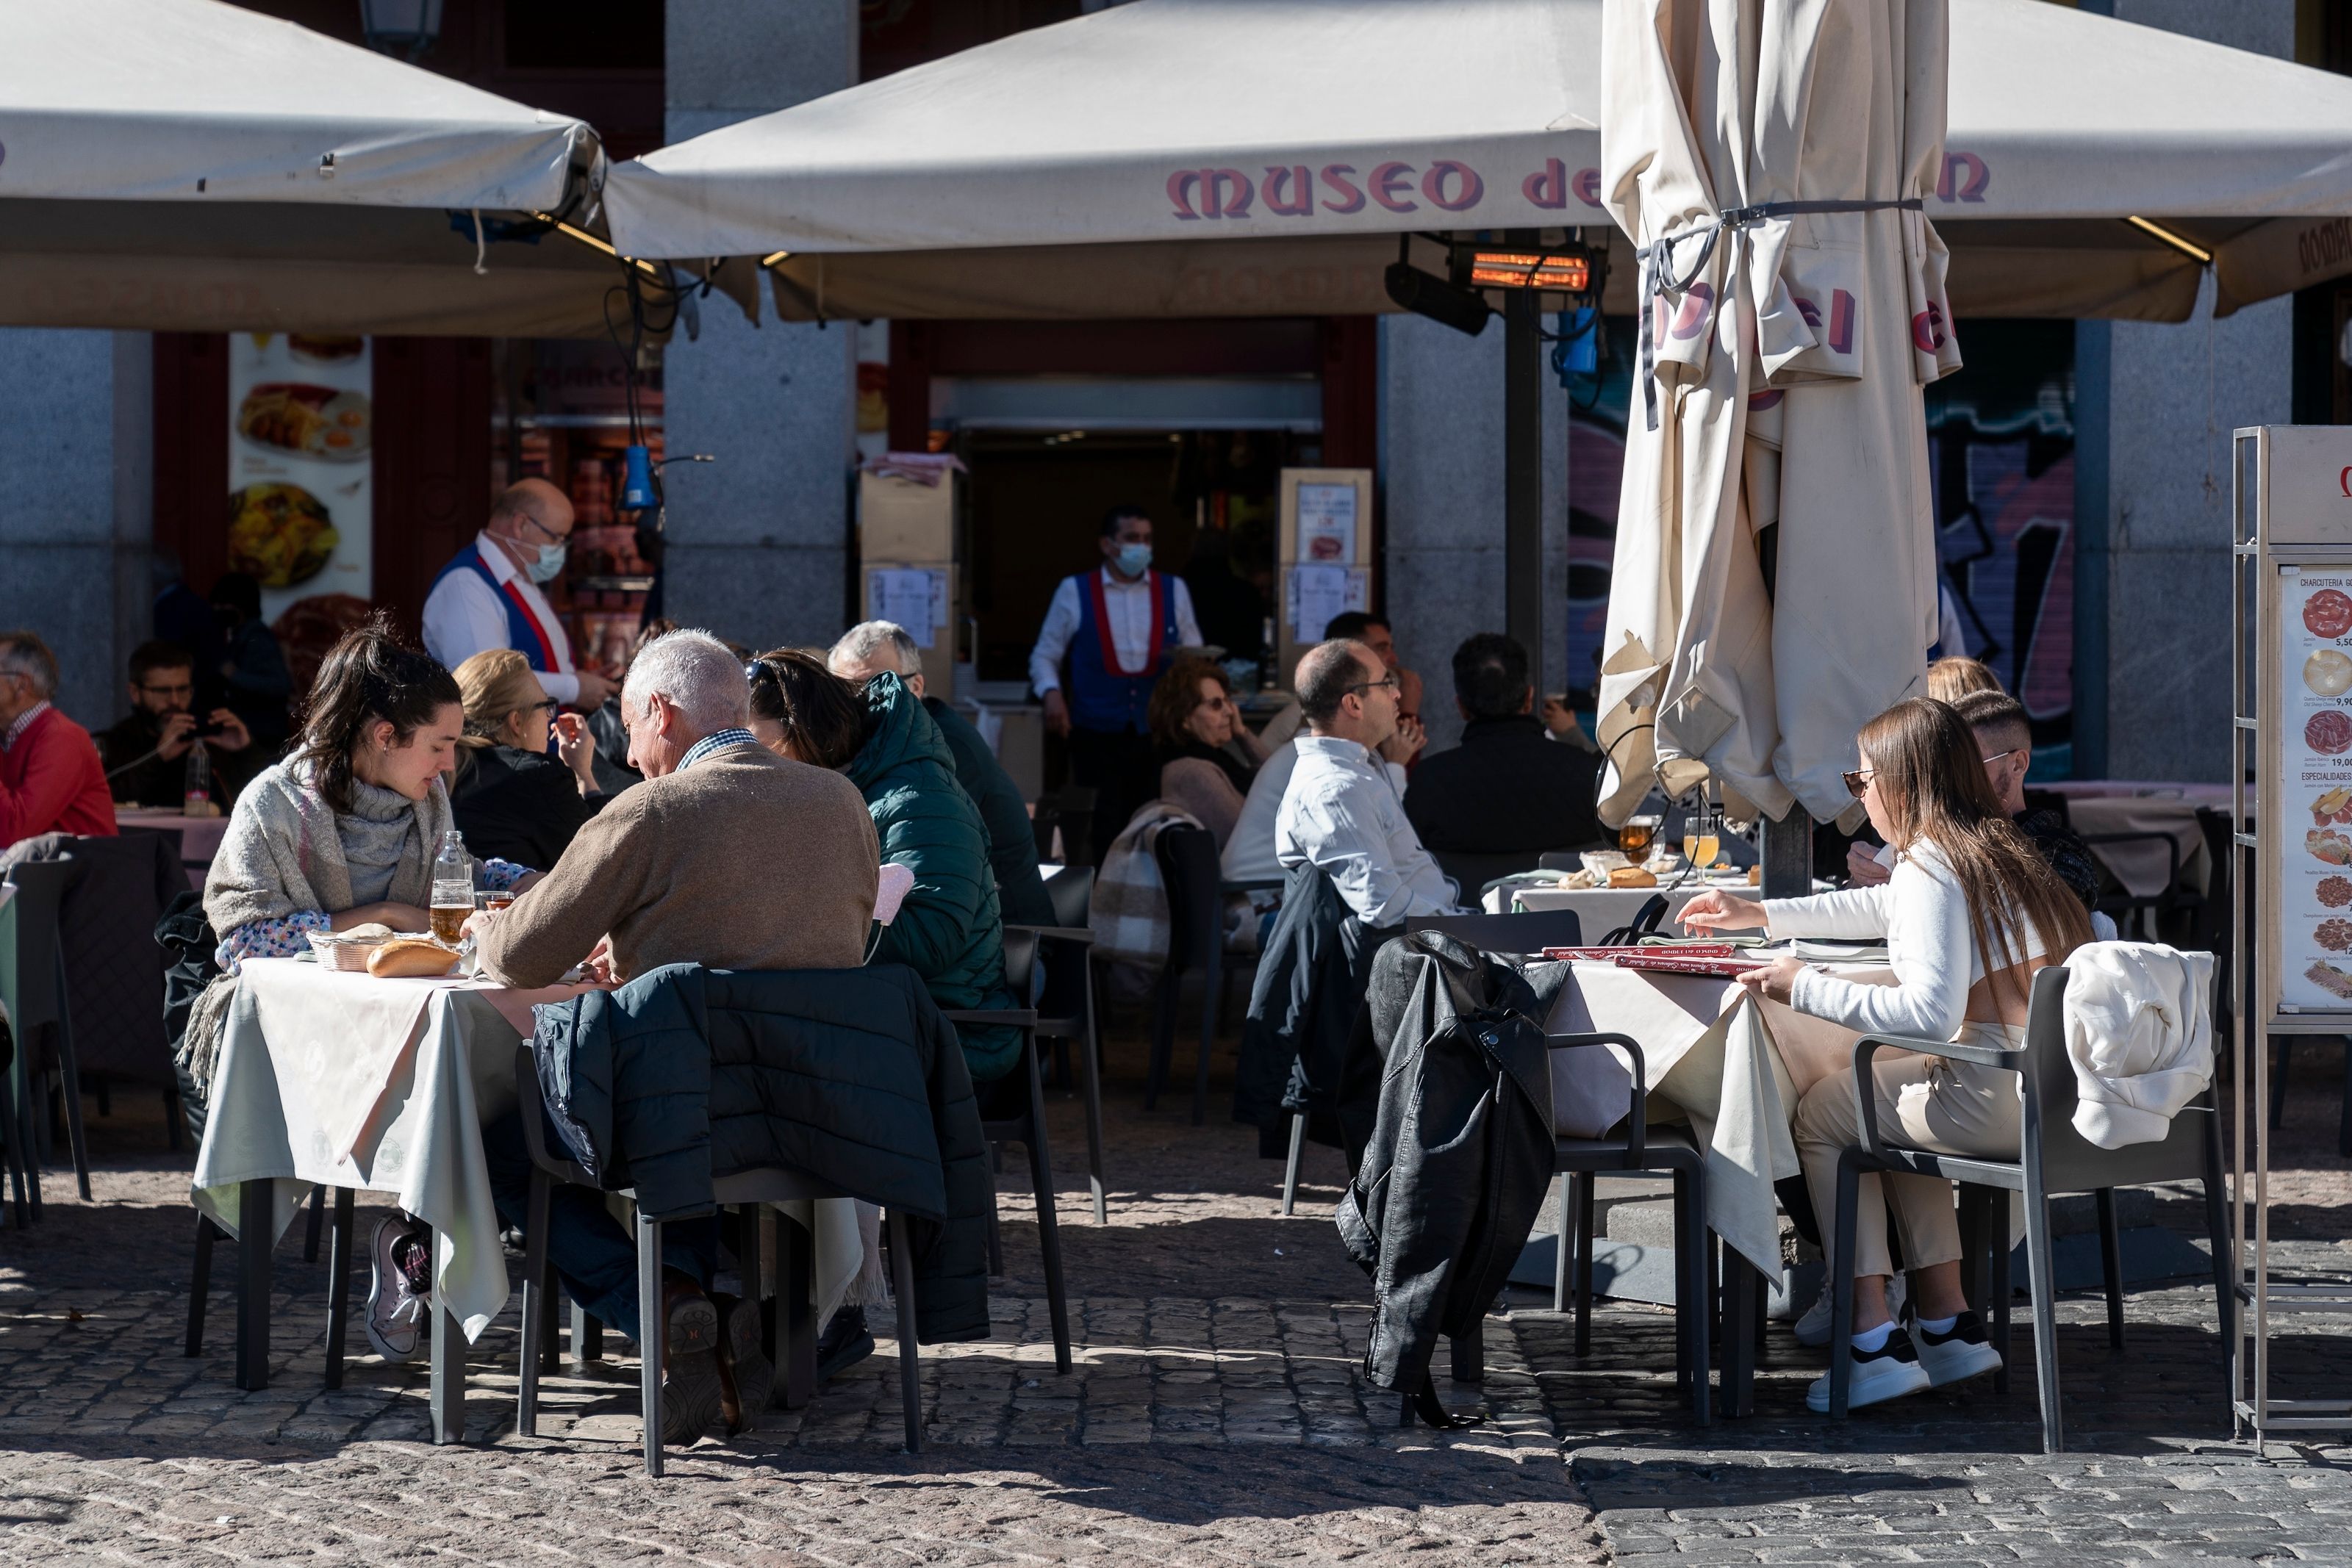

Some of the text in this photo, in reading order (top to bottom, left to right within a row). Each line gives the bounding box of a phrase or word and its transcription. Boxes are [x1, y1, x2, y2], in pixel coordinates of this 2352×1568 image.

[1521, 158, 1601, 209] de
[2301, 578, 2343, 586] CHARCUTERIA
[2302, 772, 2352, 780] ESPECIALIDADES
